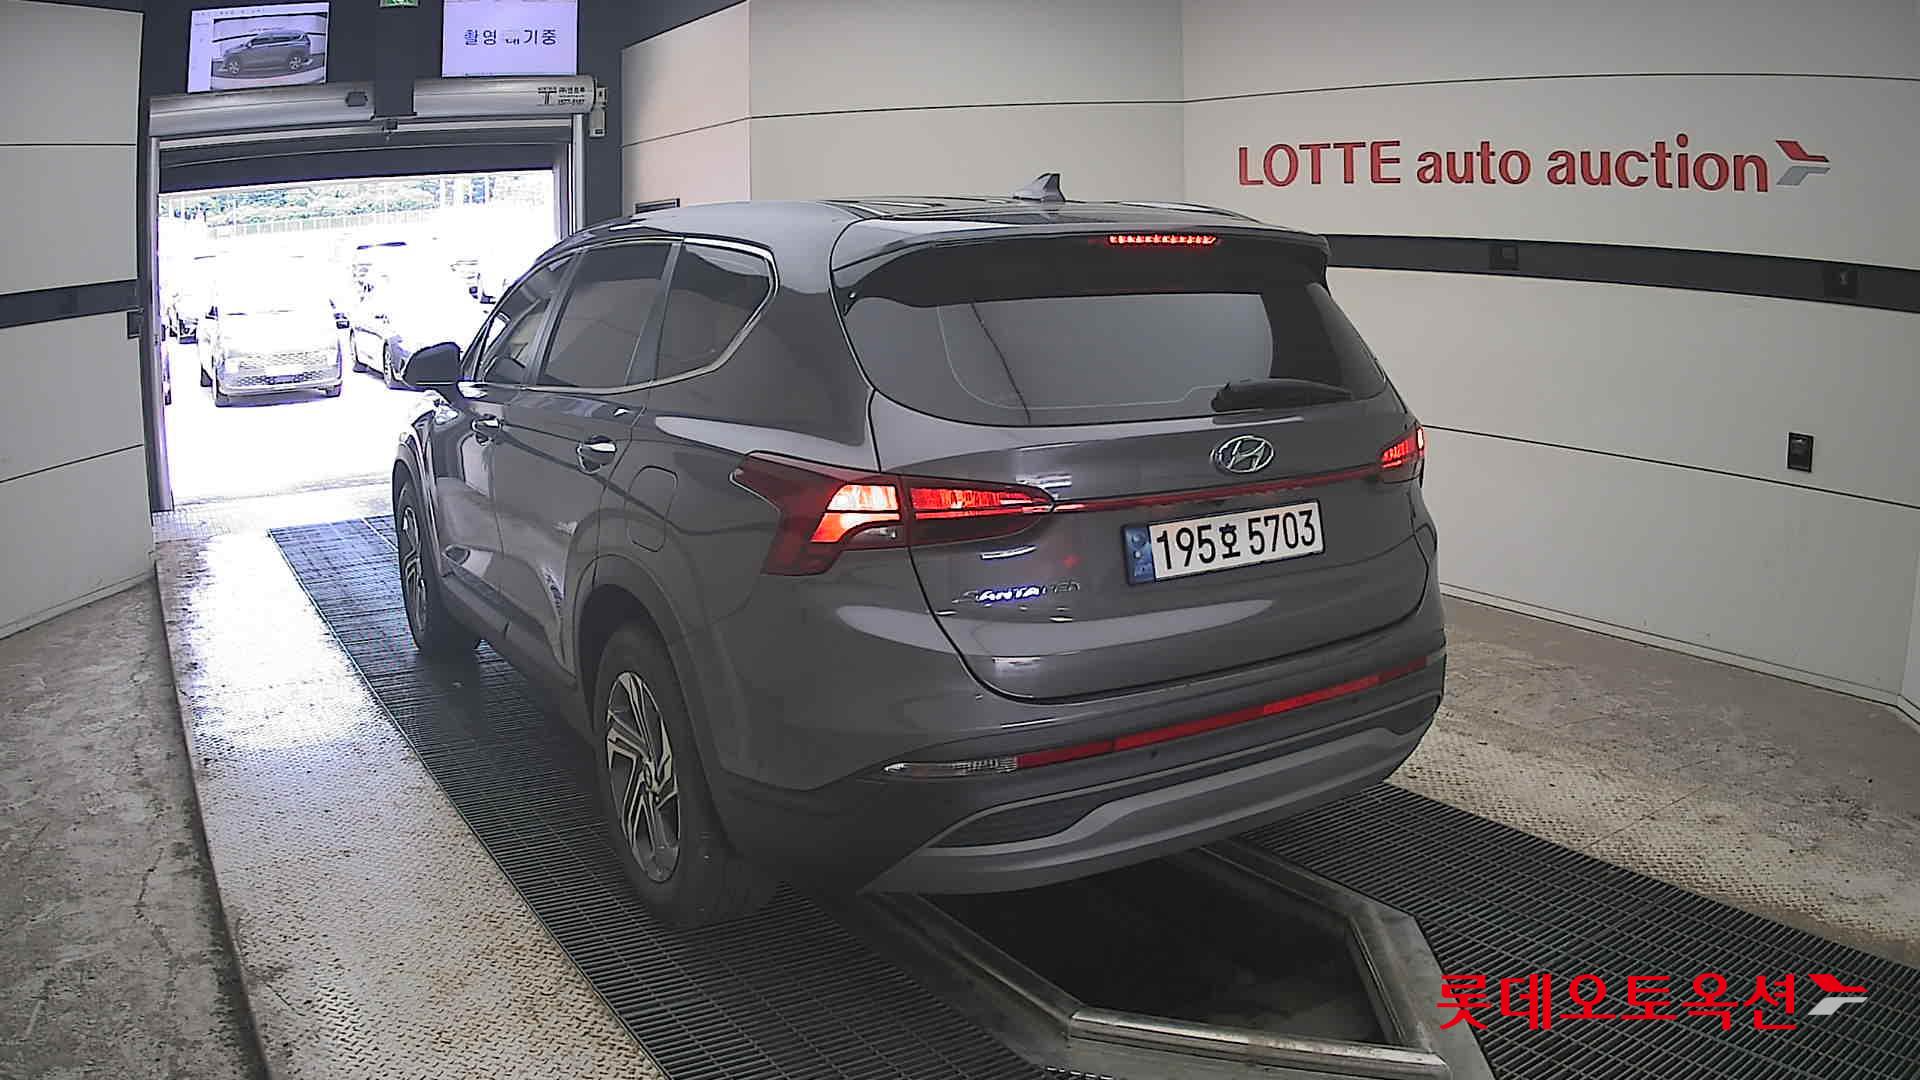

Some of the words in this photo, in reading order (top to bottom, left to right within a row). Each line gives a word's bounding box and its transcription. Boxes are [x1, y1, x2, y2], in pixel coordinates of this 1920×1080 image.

[1239, 141, 1401, 187] LOTTE
[1417, 141, 1532, 186] auto
[1547, 134, 1769, 193] auction
[1156, 522, 1241, 571] 195호
[1248, 510, 1316, 557] 5703
